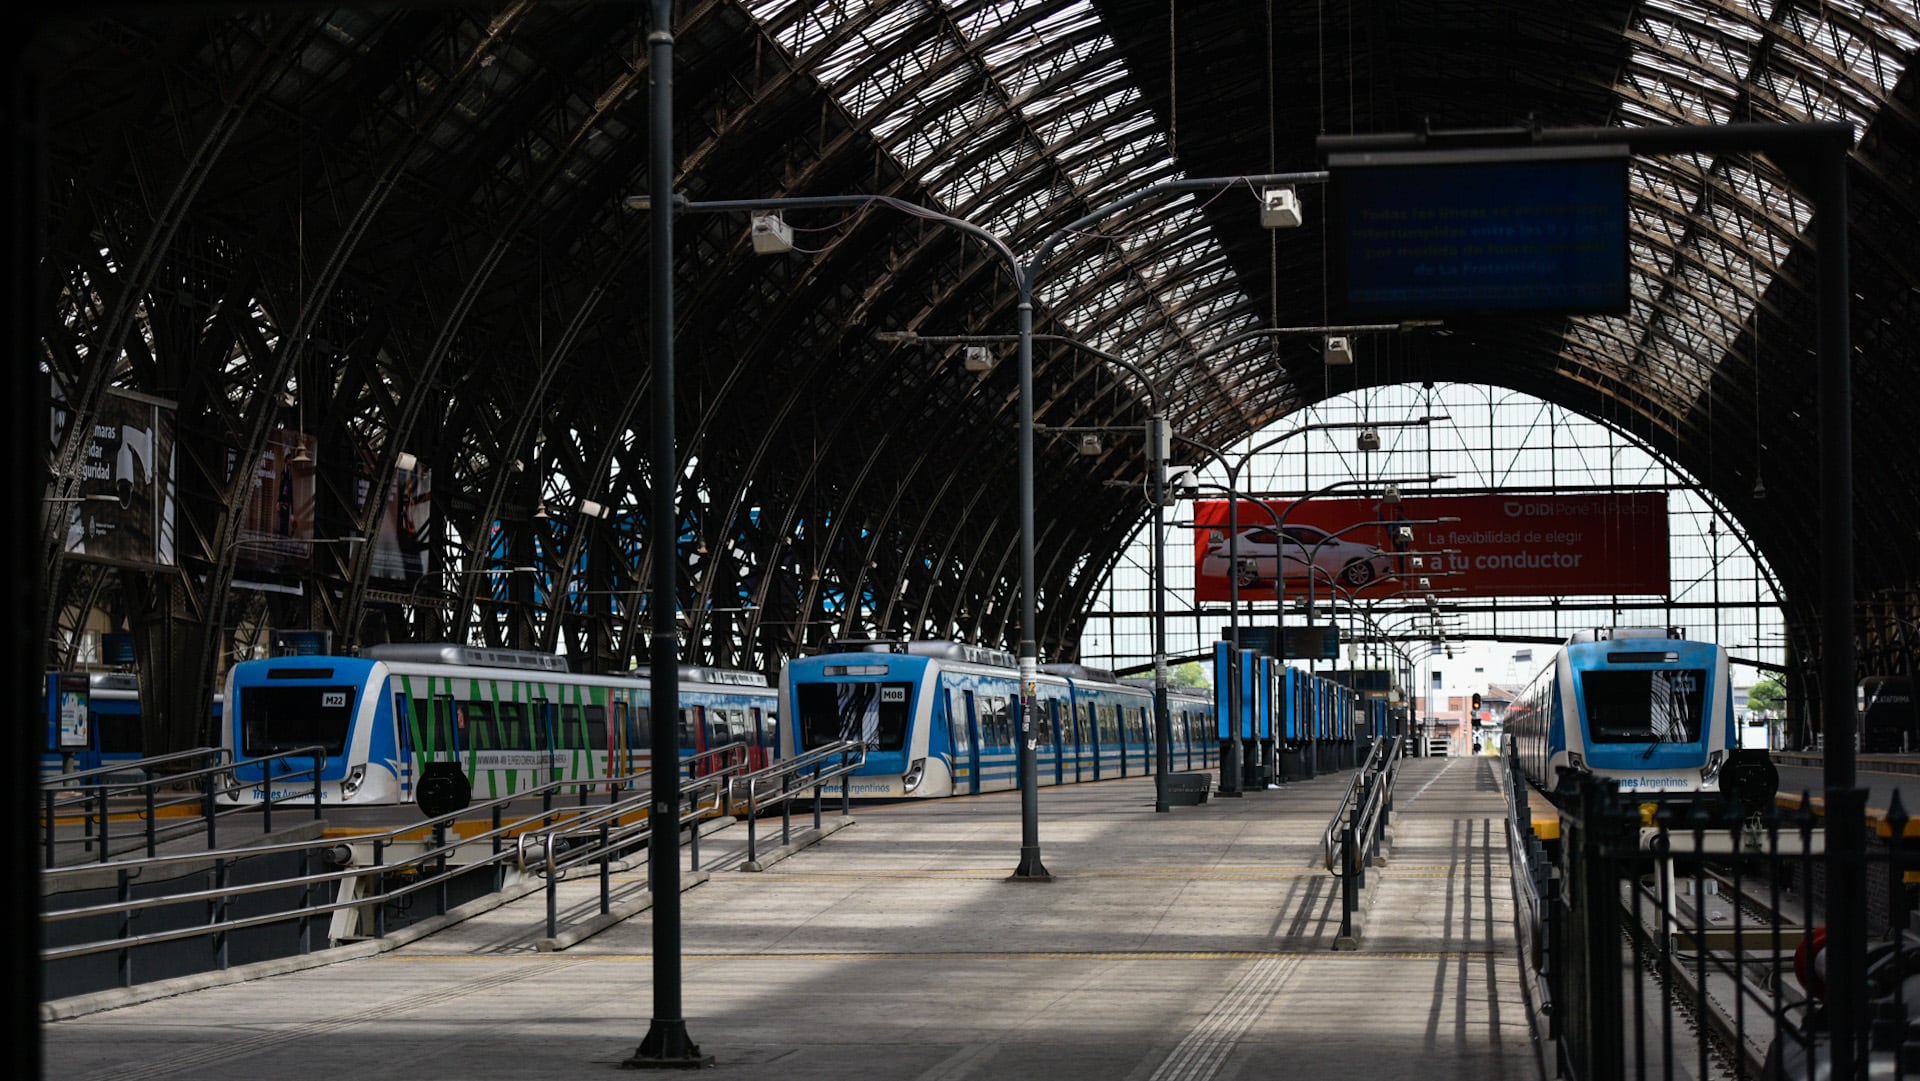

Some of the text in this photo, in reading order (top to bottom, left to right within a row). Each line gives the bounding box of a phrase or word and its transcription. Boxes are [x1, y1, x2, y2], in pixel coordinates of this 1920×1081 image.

[94, 425, 116, 439] maras
[82, 461, 110, 481] guridad
[1525, 503, 1554, 516] DiDi
[1428, 530, 1584, 545] La flexibilidad de elegir
[1430, 550, 1583, 570] a tu conductor
[325, 695, 343, 705] M22
[883, 691, 903, 700] M08
[1640, 776, 1688, 788] Argentinos
